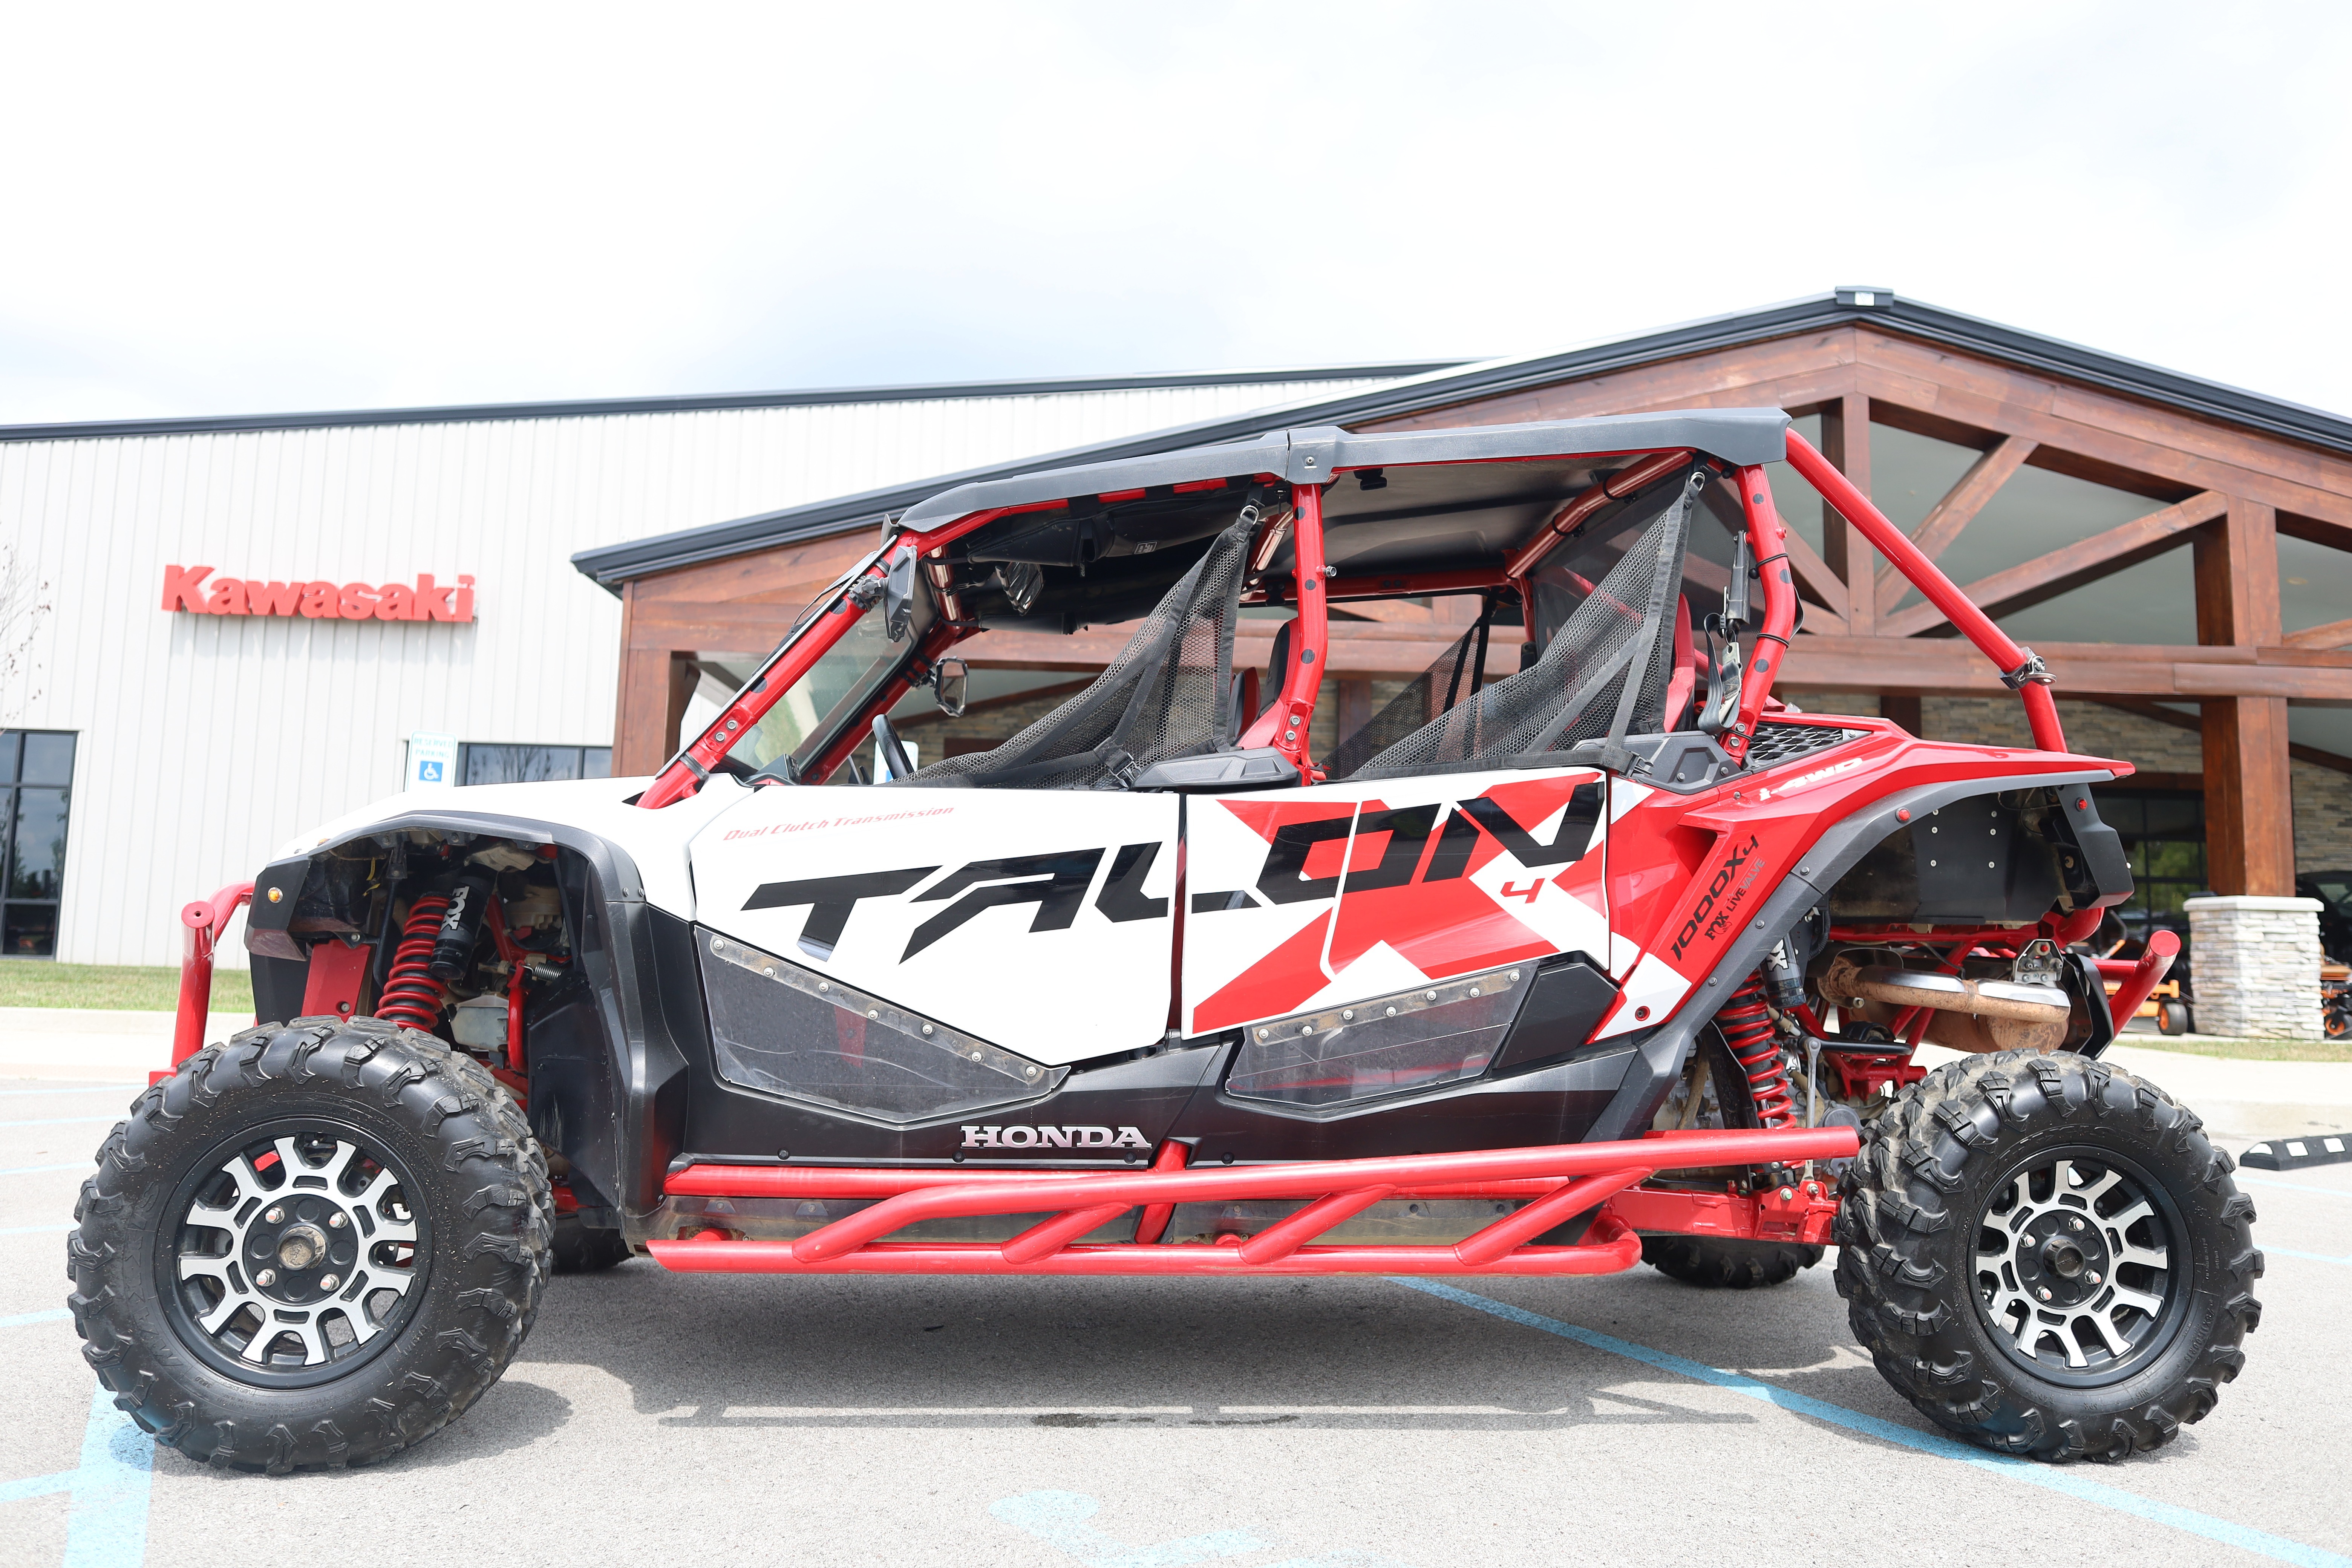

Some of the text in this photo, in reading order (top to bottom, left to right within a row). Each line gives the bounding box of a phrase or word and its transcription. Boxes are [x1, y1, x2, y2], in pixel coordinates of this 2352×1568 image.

[162, 563, 475, 623] Kawasaki
[414, 737, 453, 747] RESERVED
[416, 749, 449, 758] PARKING
[723, 807, 954, 841] Dual Clutch Transmission
[741, 781, 1605, 964] TALON
[1500, 878, 1545, 903] 4
[440, 886, 470, 931] FOX
[1704, 911, 1729, 940] FOX
[961, 1125, 1152, 1148] HONDA
[124, 1181, 184, 1366] MAXXIS
[195, 1376, 212, 1388] 3820
